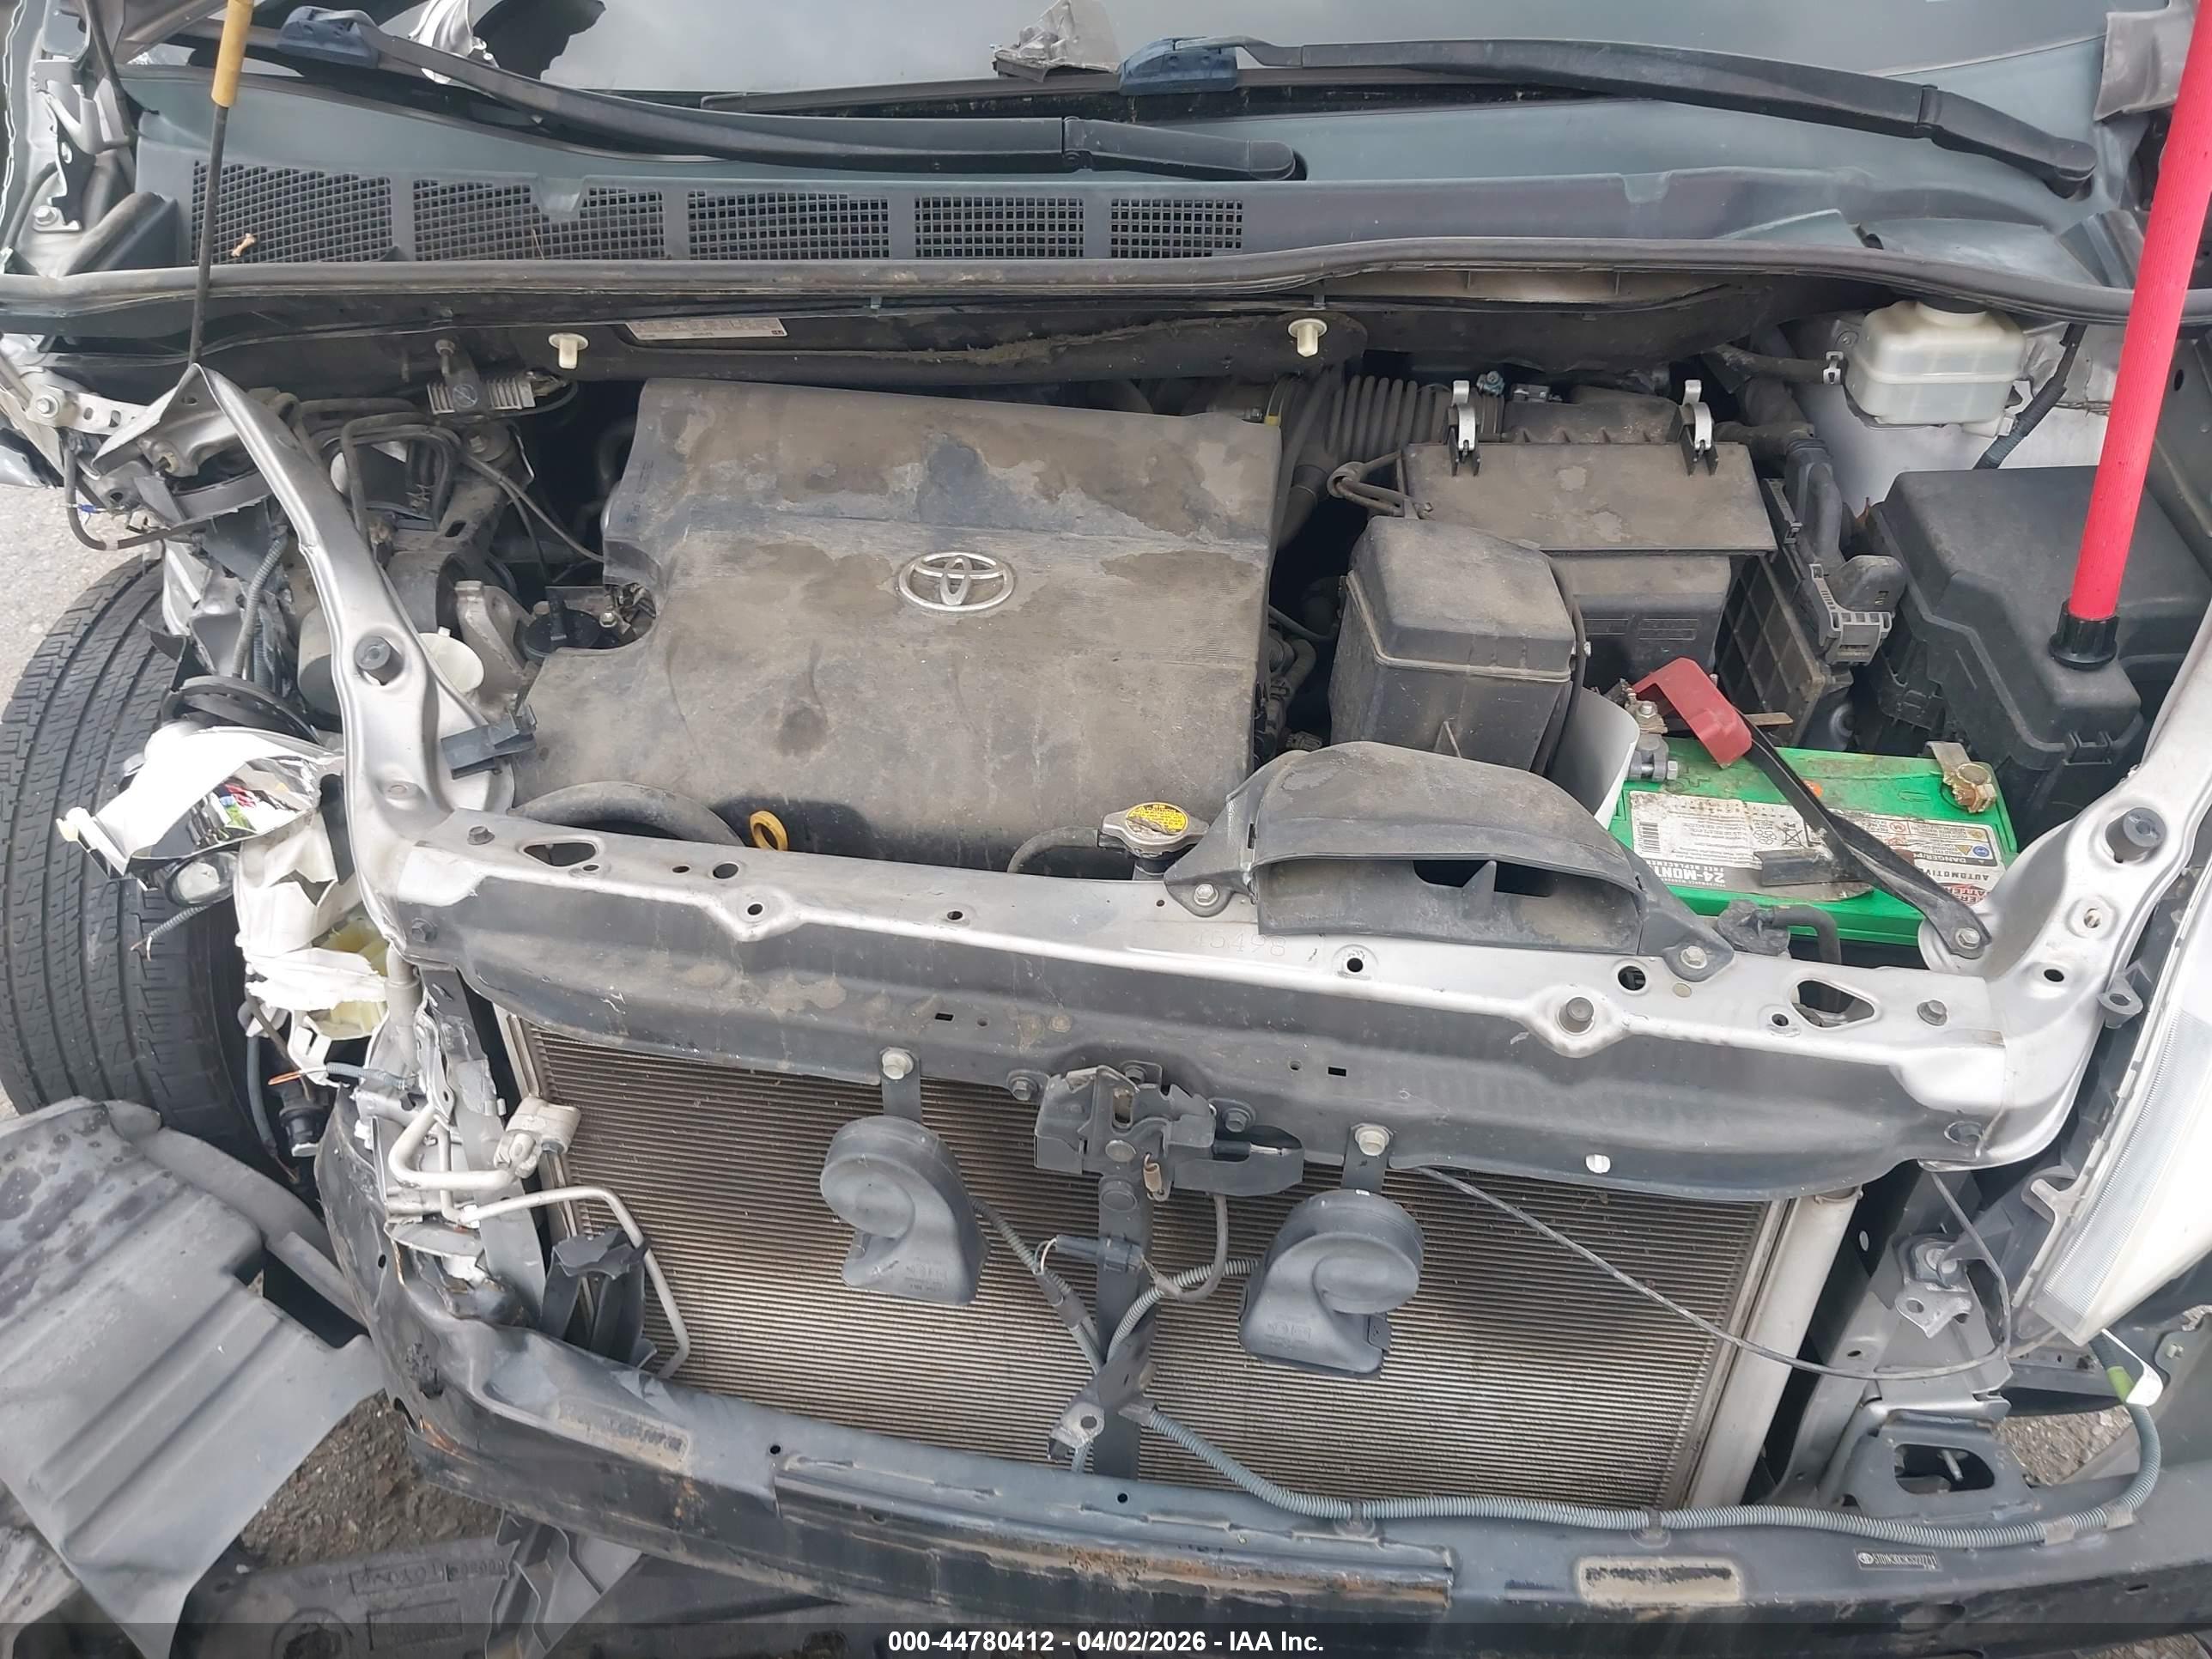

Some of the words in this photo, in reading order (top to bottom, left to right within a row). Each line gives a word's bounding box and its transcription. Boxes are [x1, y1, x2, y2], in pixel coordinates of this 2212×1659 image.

[1645, 860, 1700, 871] REPLACEMEN
[1653, 866, 1725, 883] 24-MONT
[1922, 869, 1990, 881] AUTOMOTIV
